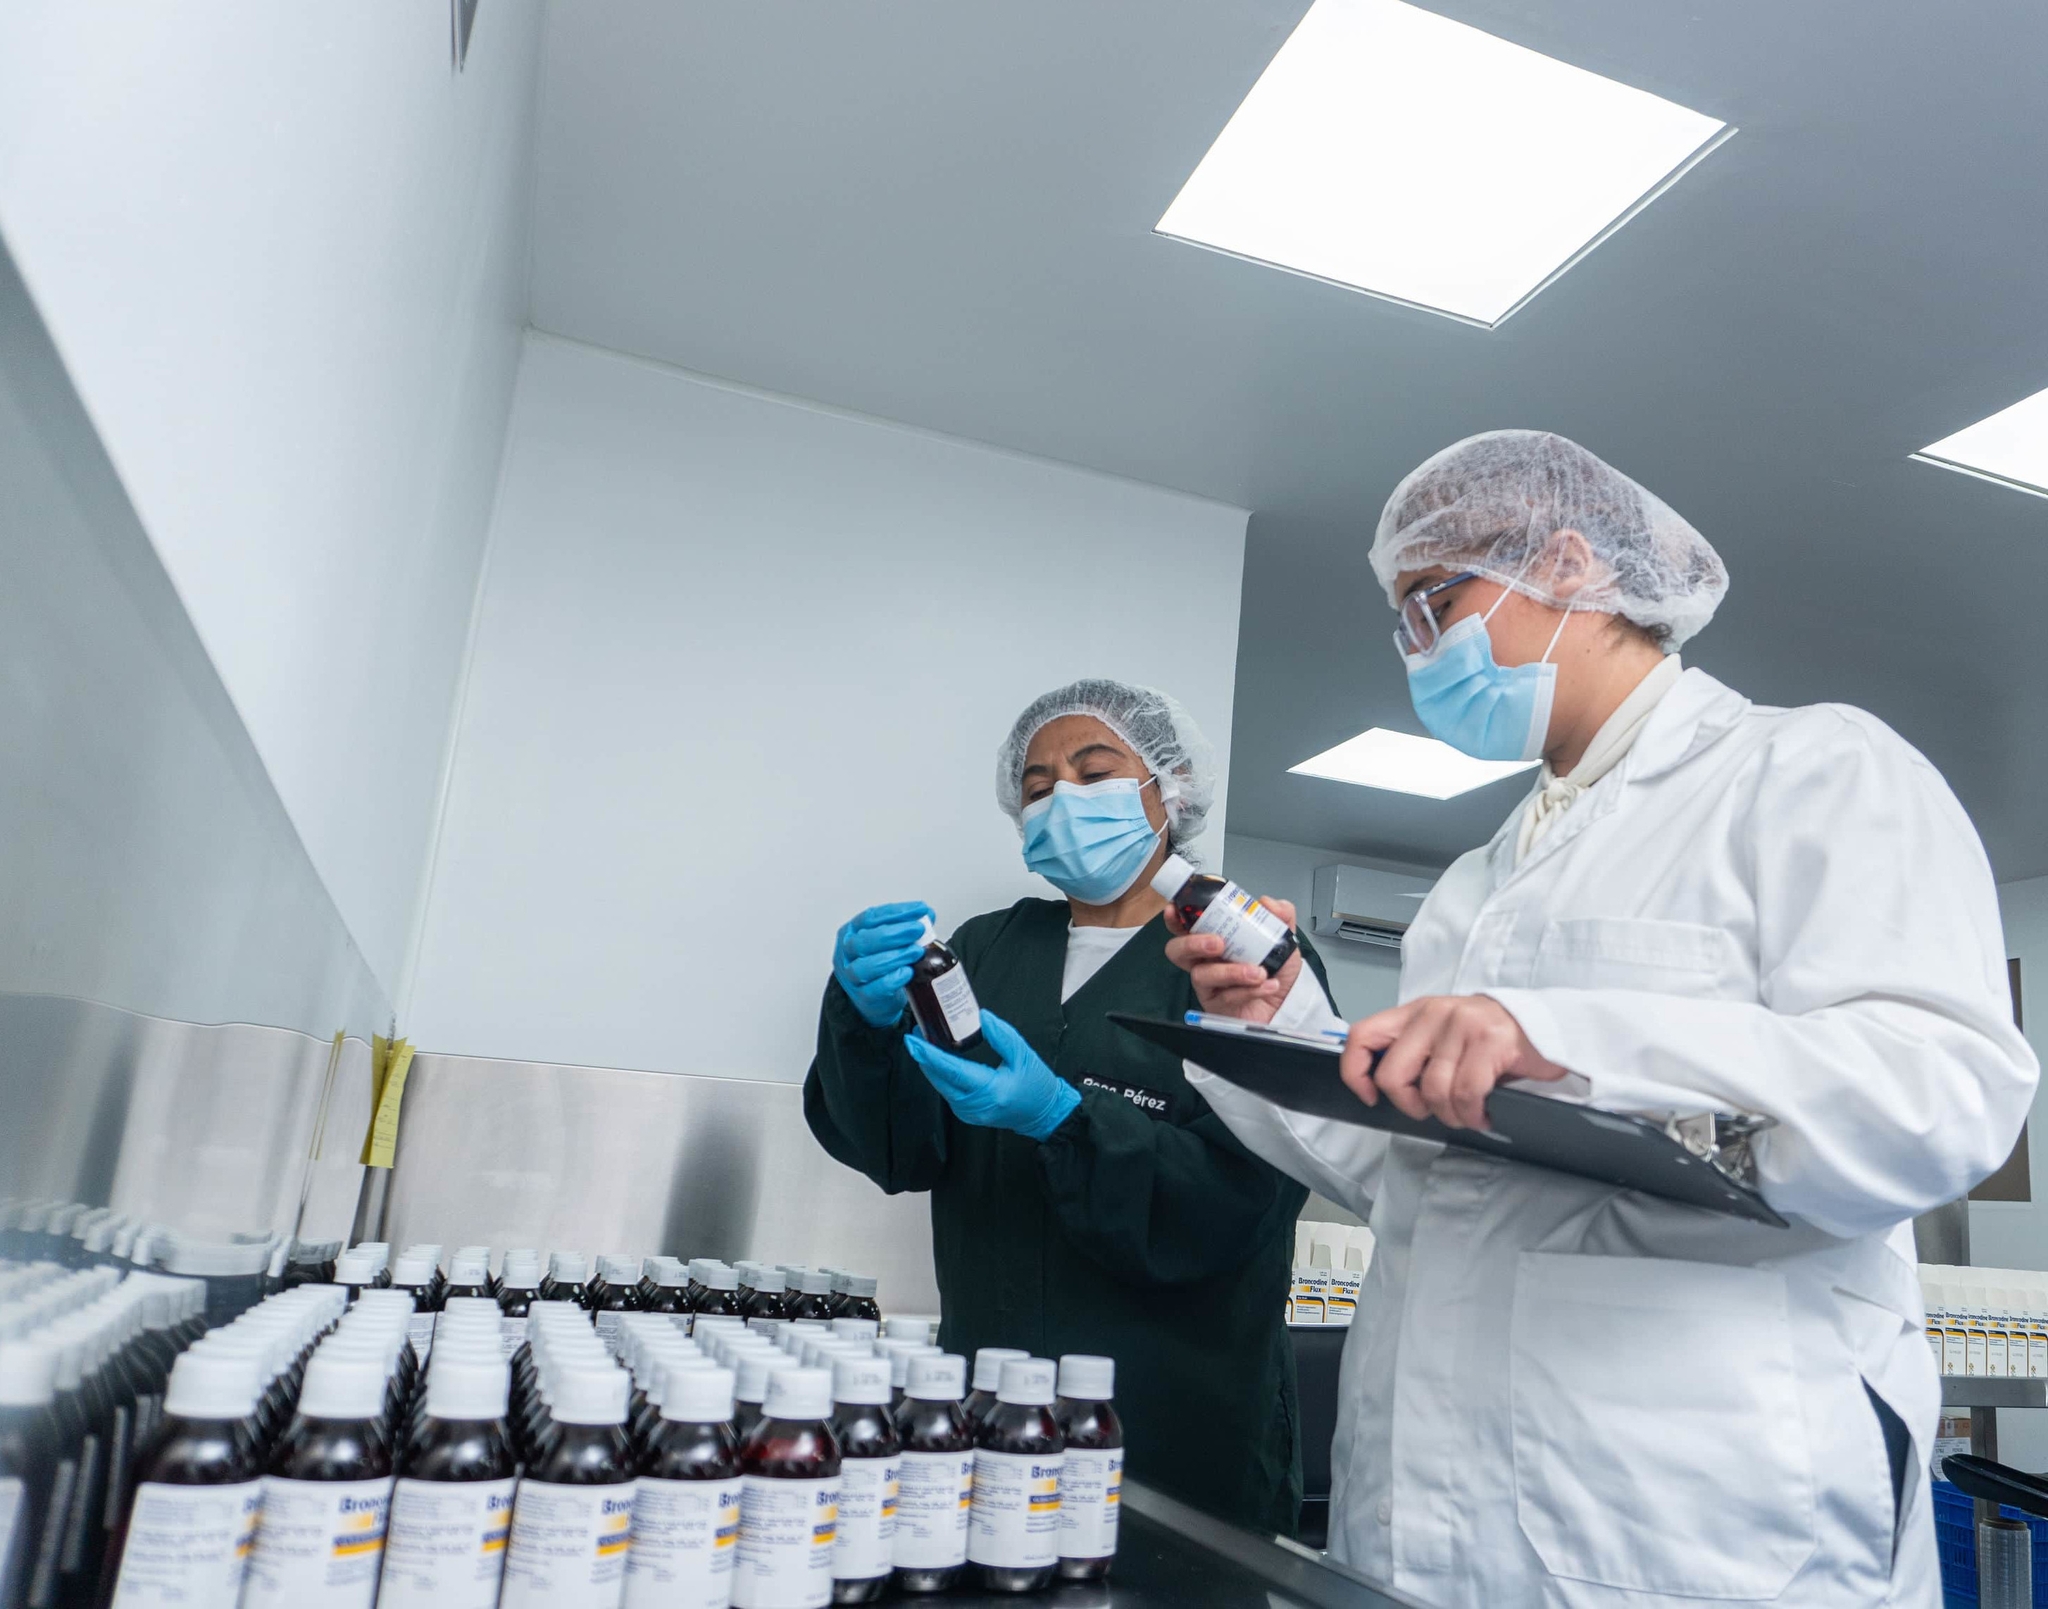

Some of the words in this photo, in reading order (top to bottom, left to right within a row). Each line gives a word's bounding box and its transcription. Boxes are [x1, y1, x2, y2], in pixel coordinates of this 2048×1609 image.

[1123, 1088, 1166, 1111] Pérez
[1298, 1277, 1328, 1286] Broncodine
[1331, 1278, 1360, 1288] Broncodine
